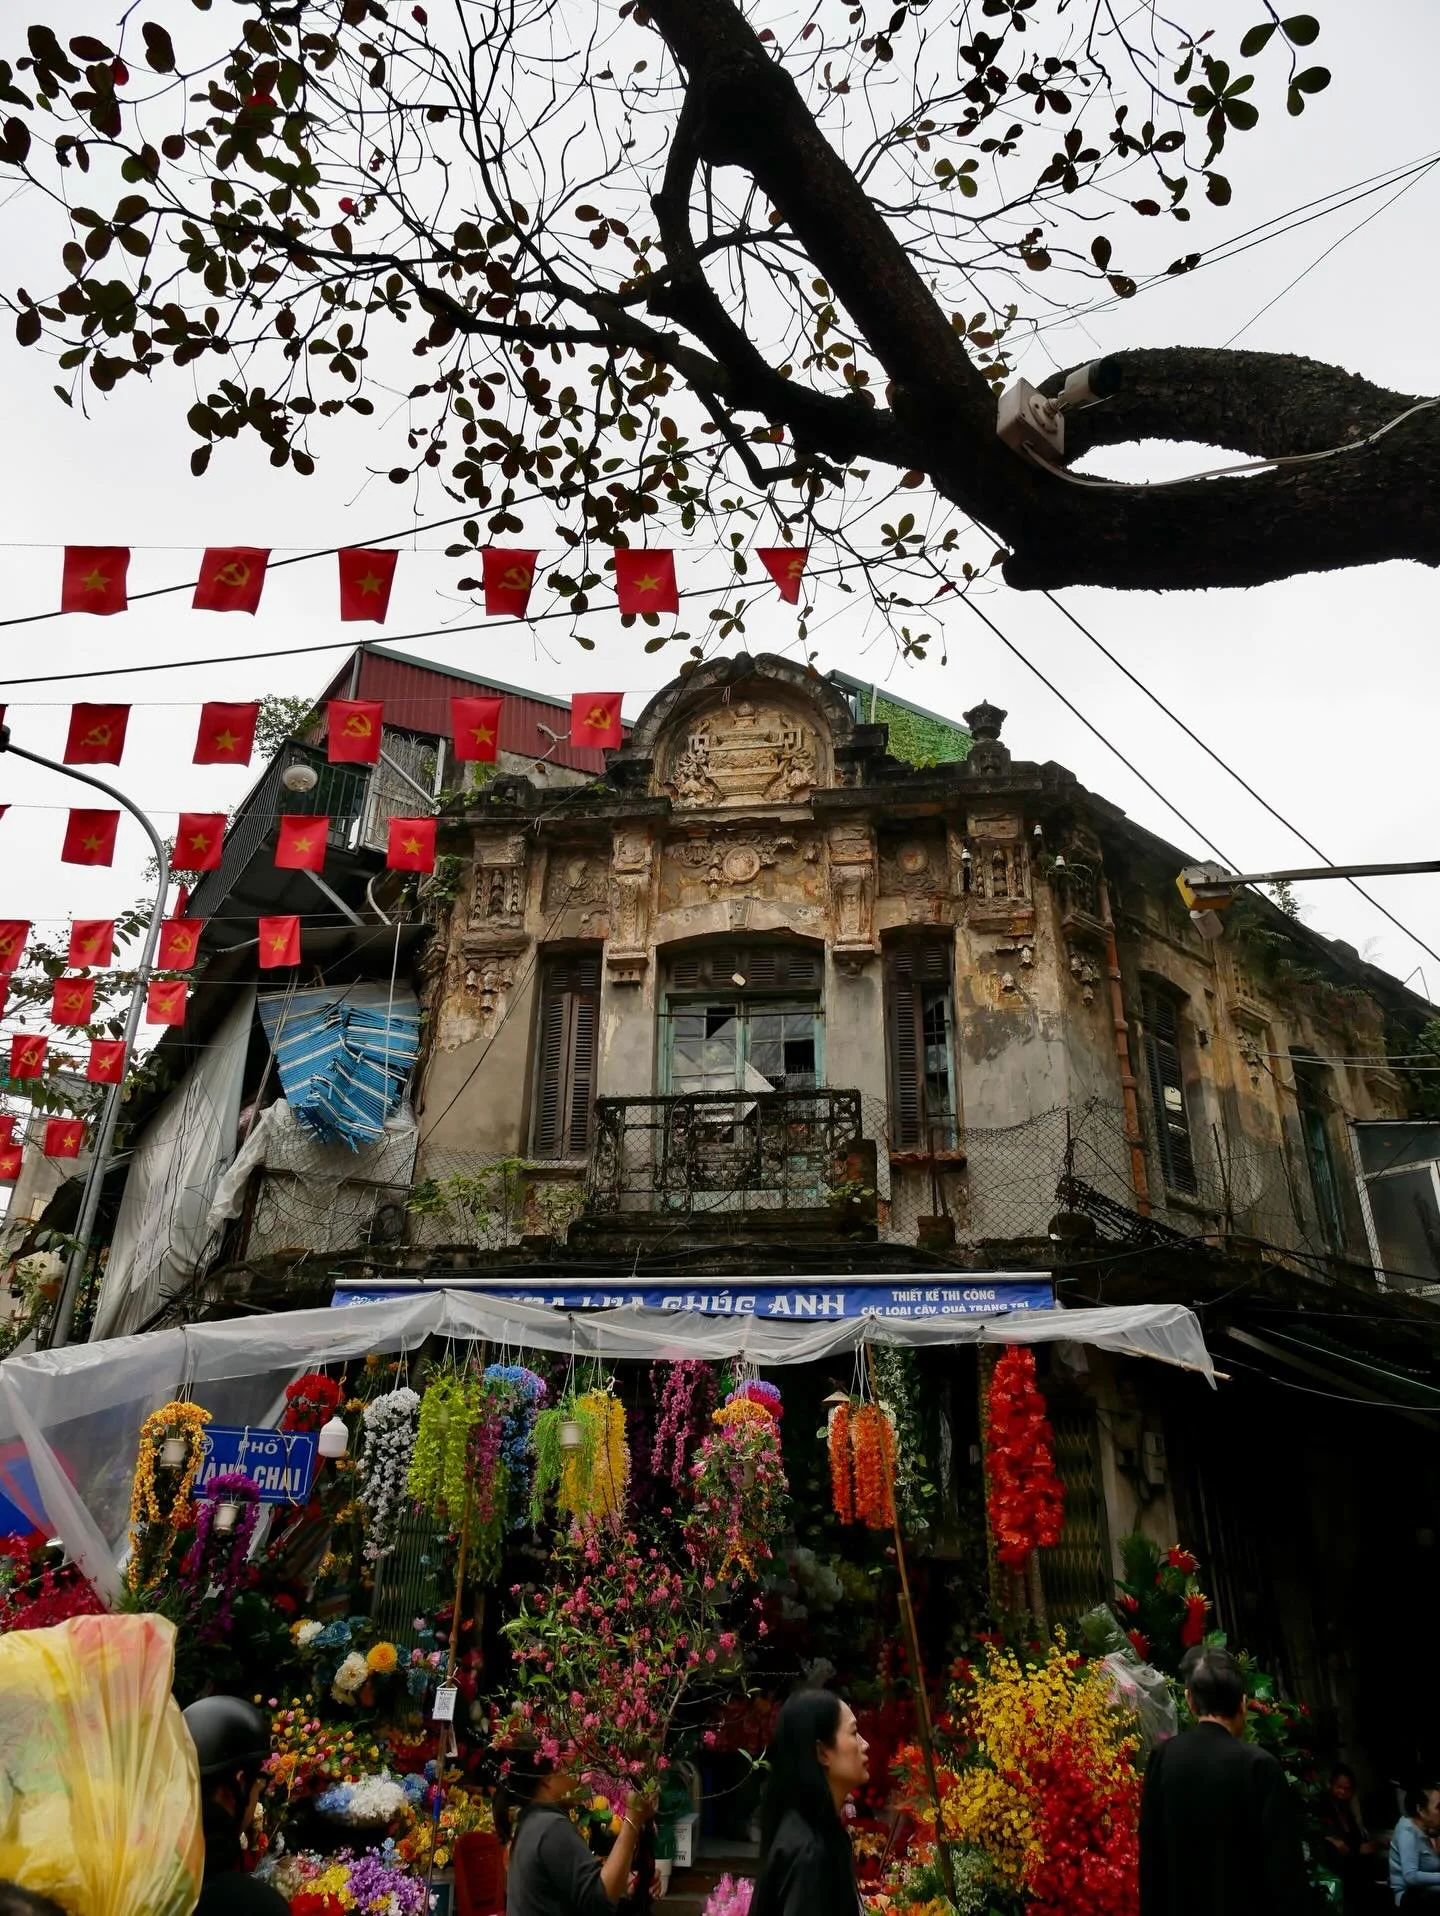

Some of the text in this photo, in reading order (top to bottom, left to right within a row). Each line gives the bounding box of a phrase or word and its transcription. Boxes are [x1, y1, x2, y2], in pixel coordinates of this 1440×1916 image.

[891, 1288, 995, 1302] THIẾT KẾ THI CÔNG
[768, 1294, 845, 1315] ANH
[969, 1304, 1008, 1312] TRANG
[238, 1438, 280, 1455] PHỐ
[252, 1465, 301, 1491] CHAI
